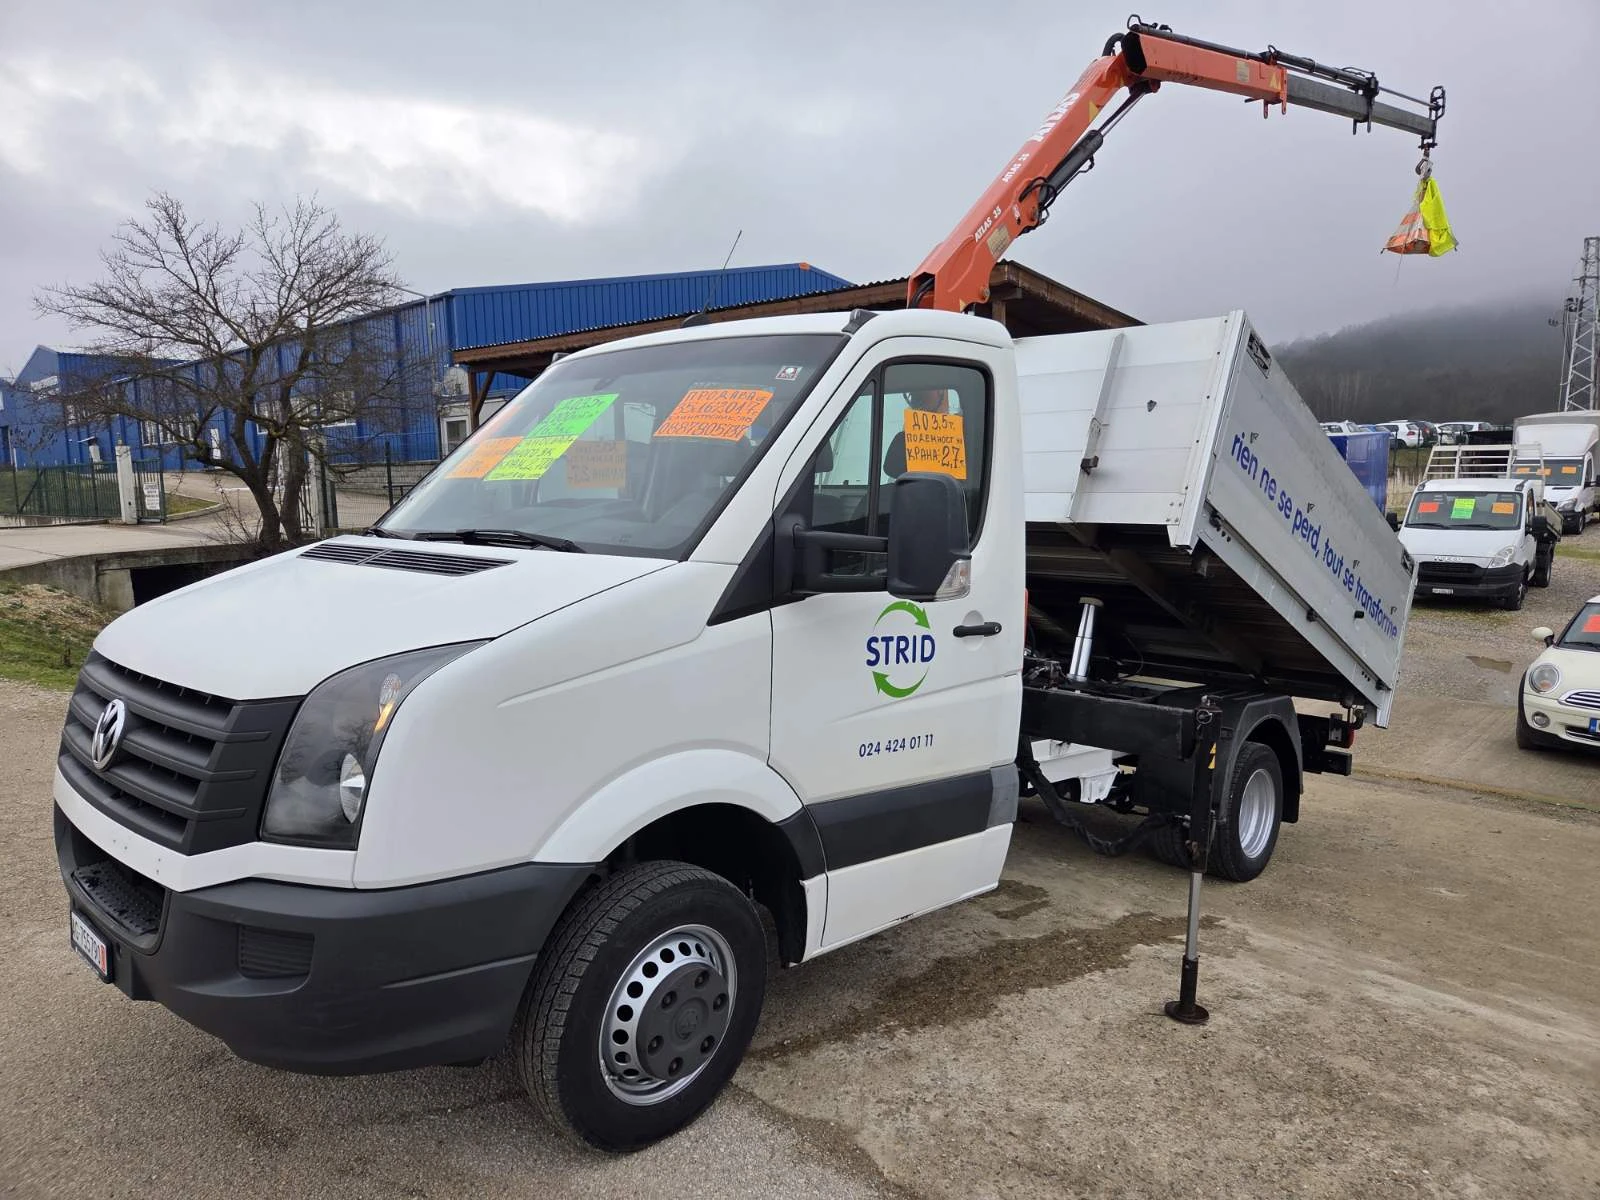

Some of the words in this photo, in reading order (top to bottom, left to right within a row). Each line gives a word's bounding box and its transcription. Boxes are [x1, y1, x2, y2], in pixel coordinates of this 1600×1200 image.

[975, 217, 993, 243] ATLAS
[1231, 432, 1258, 480] rien
[1259, 467, 1277, 501] ne
[1277, 490, 1293, 519] se
[1292, 507, 1322, 558] perd,
[1322, 538, 1344, 579] tout
[1342, 567, 1355, 592] se
[1354, 576, 1398, 638] transforme
[866, 634, 936, 667] STRID
[859, 741, 881, 758] 024
[885, 738, 906, 753] 424
[909, 735, 921, 748] 01
[925, 733, 934, 747] 11
